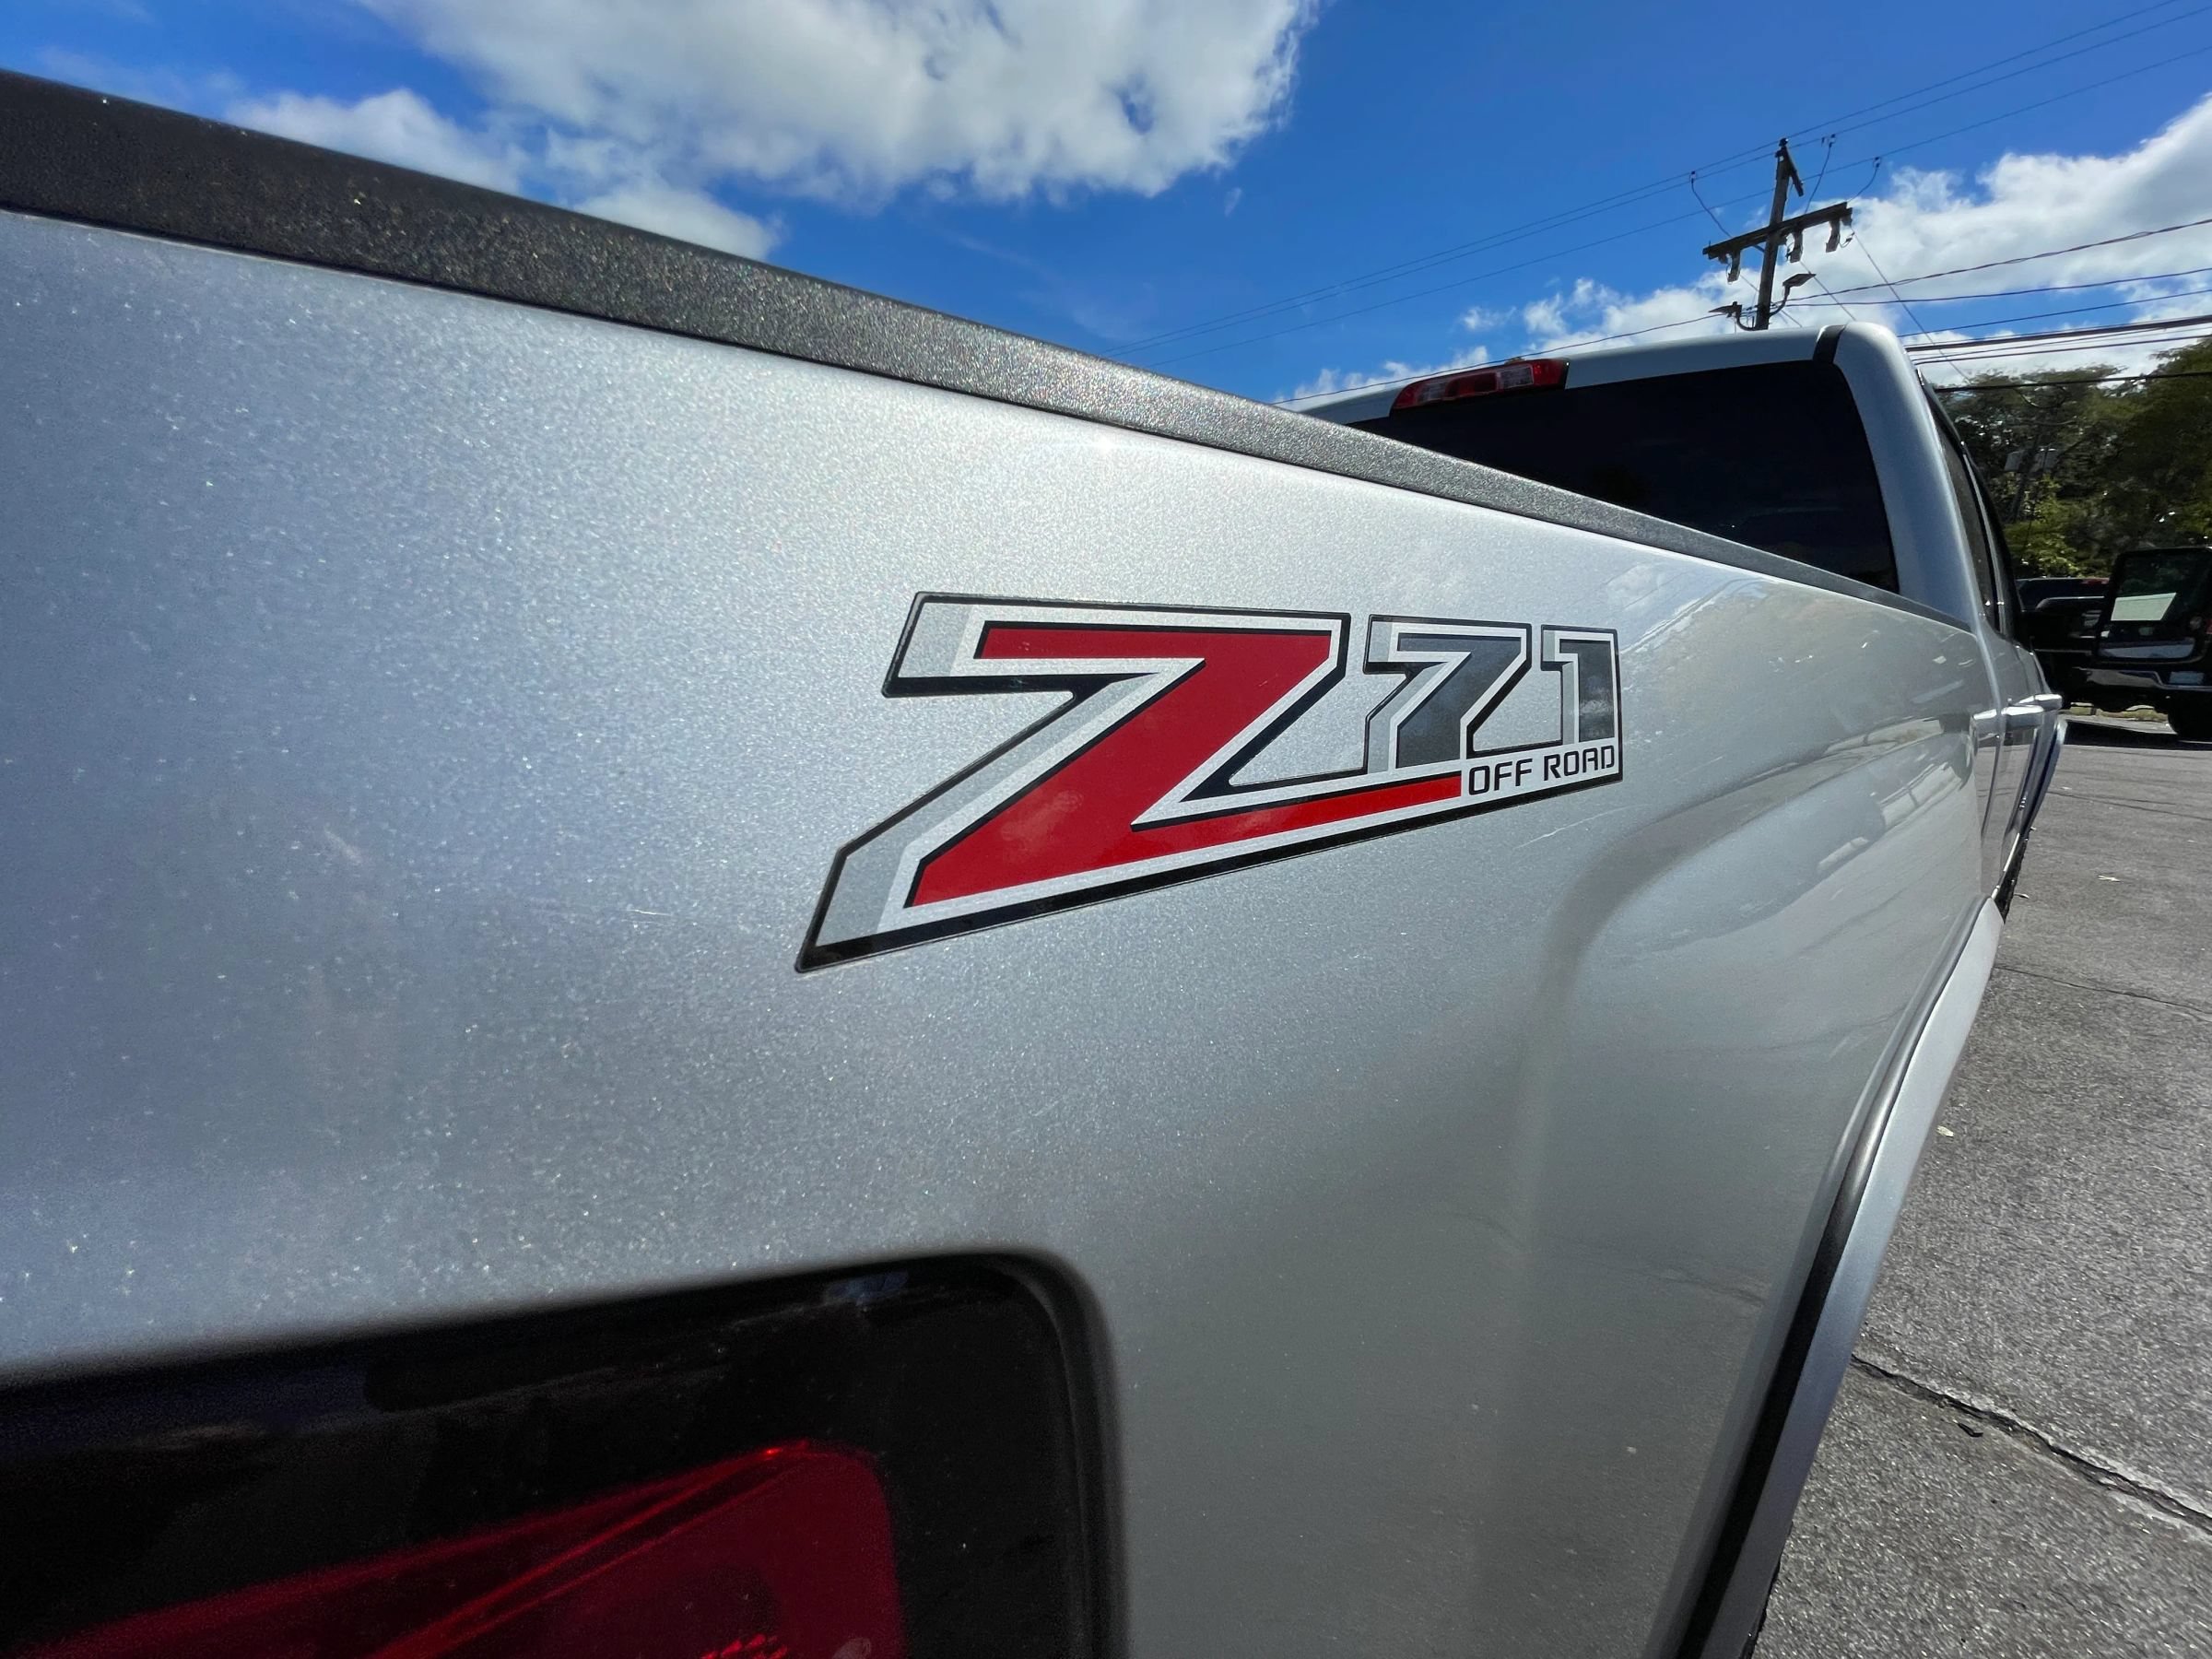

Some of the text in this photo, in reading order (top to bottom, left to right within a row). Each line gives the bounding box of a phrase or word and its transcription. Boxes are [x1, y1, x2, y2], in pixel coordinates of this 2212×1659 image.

[798, 592, 1622, 971] Z71
[1468, 745, 1615, 795] OFF ROAD
